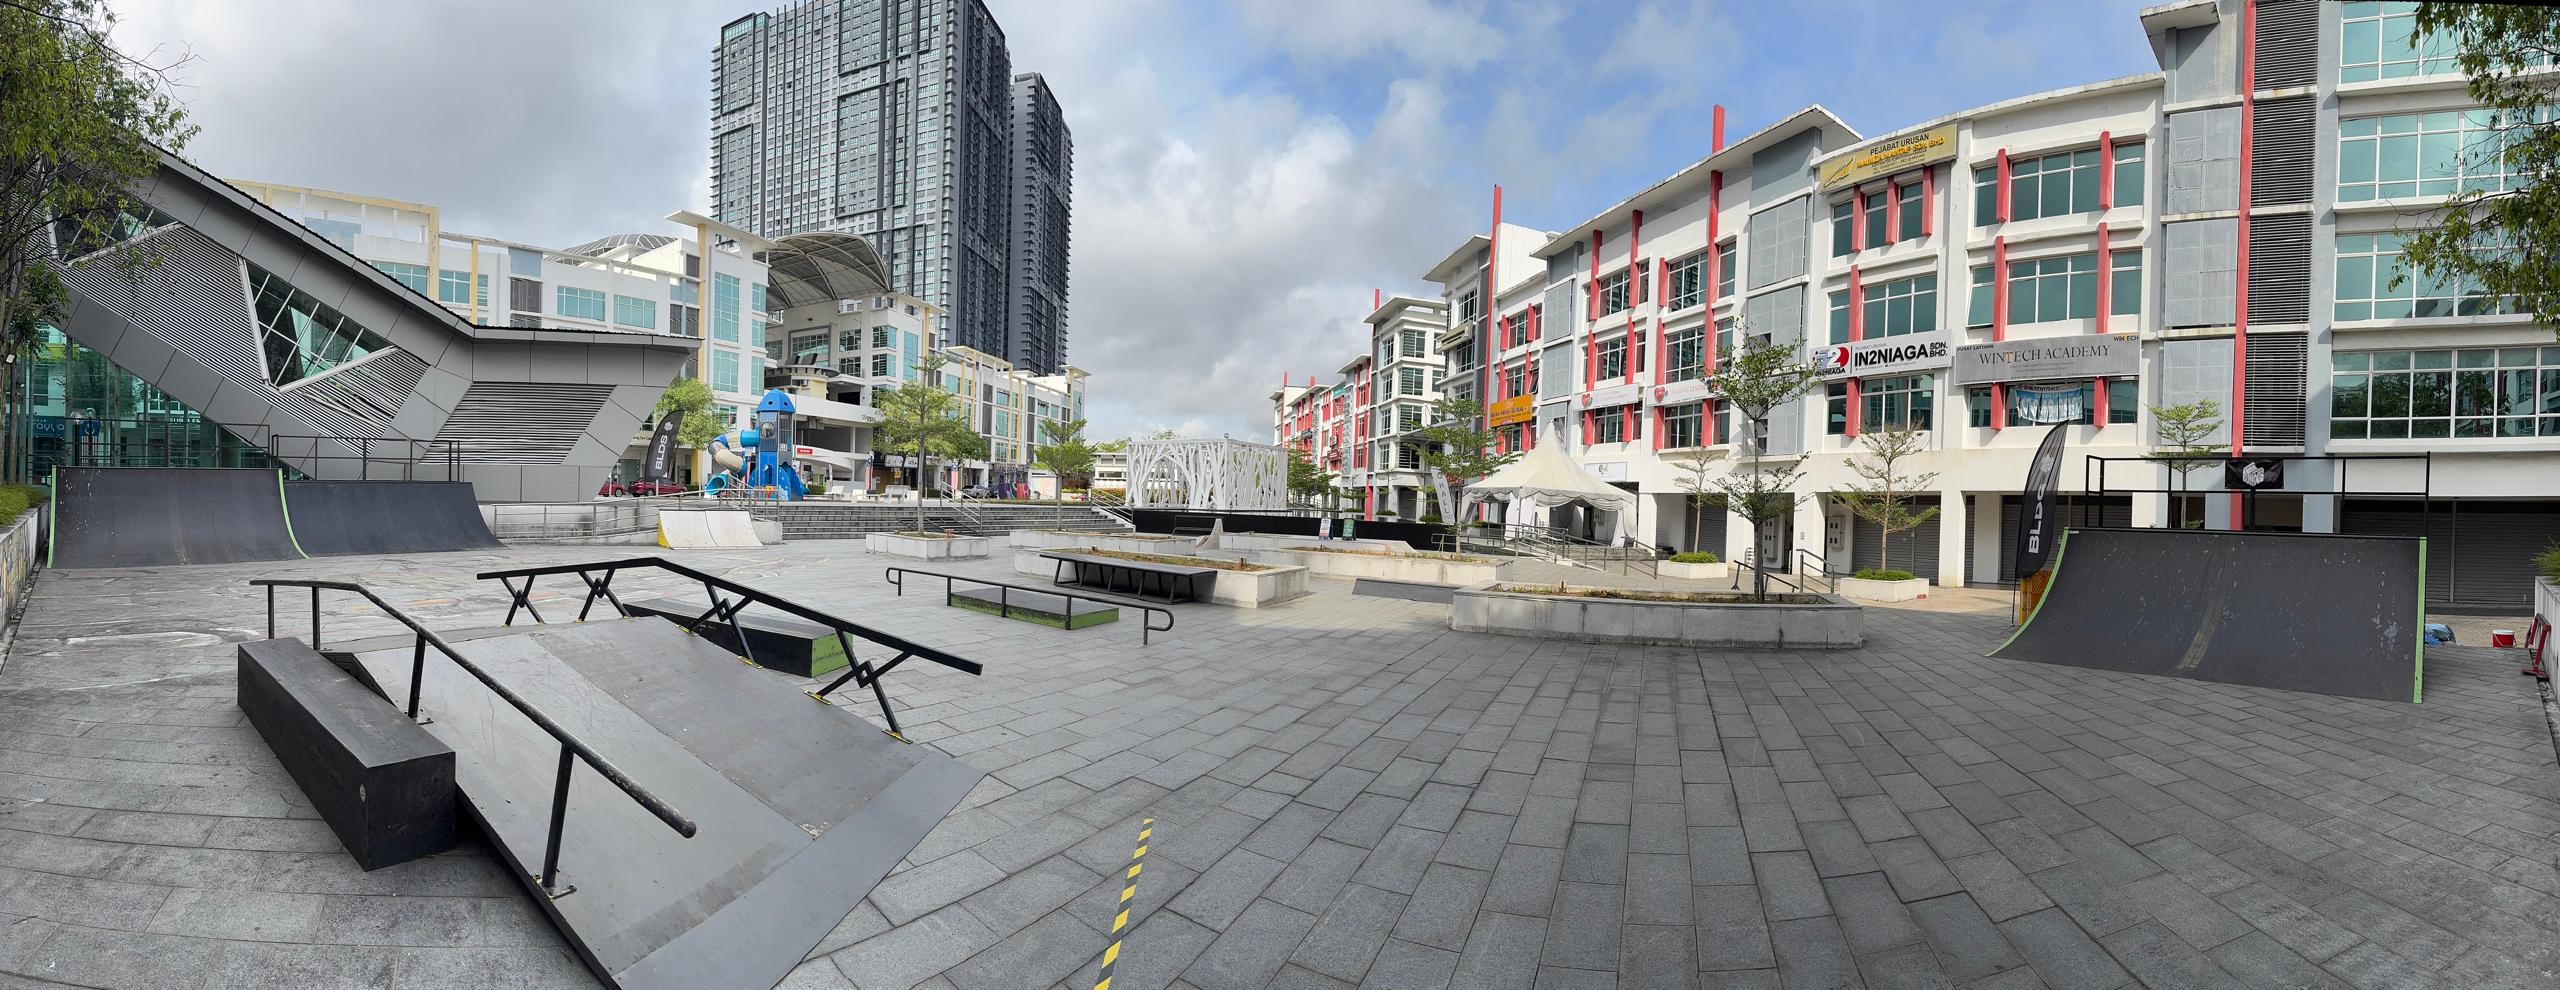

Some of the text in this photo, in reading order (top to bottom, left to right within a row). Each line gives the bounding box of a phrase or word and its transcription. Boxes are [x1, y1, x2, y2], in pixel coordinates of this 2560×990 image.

[1870, 133, 1930, 155] PEJABAT URUSAN
[1855, 343, 1929, 367] IN2NIAGA
[1930, 341, 1948, 350] SDN.
[1930, 348, 1948, 358] BHD.
[1979, 344, 2112, 364] WINTECH ACADEMY
[655, 434, 668, 470] BLDS
